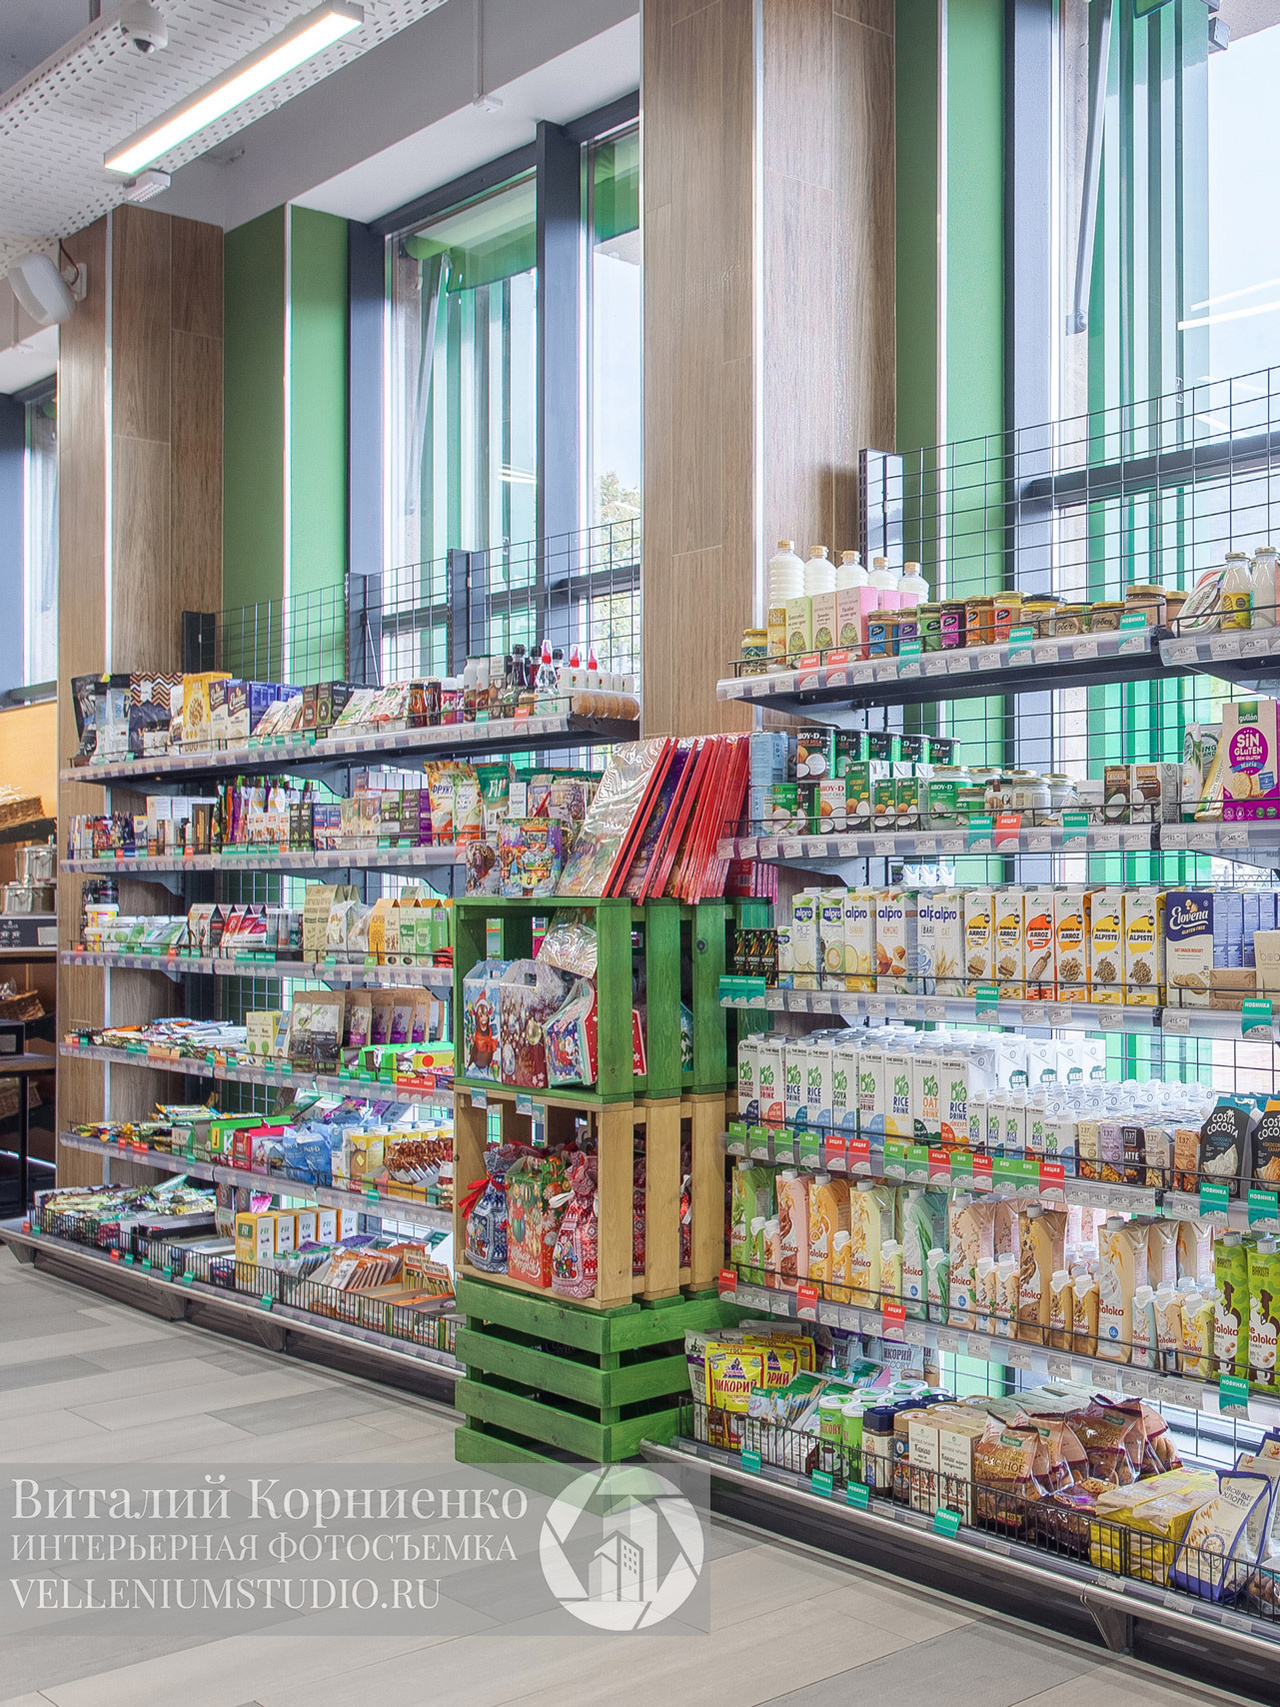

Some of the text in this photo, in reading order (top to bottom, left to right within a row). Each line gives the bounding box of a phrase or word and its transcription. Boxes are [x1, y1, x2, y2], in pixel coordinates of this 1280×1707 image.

[1122, 616, 1145, 624] НОВИНКА
[795, 908, 812, 917] alpro
[845, 908, 868, 921] alpro
[878, 907, 902, 922] alpro
[934, 908, 957, 923] alpro
[1170, 905, 1209, 930] Elovena
[1095, 933, 1118, 941] ALPISTE
[923, 1098, 939, 1109] OAT
[1212, 1112, 1236, 1130] COSTA
[1206, 1122, 1239, 1139] COCOSTA
[1202, 1186, 1227, 1196] НОВИНКА
[1250, 1193, 1275, 1202] НОВИНКА
[1222, 1378, 1247, 1389] НОВИНКА
